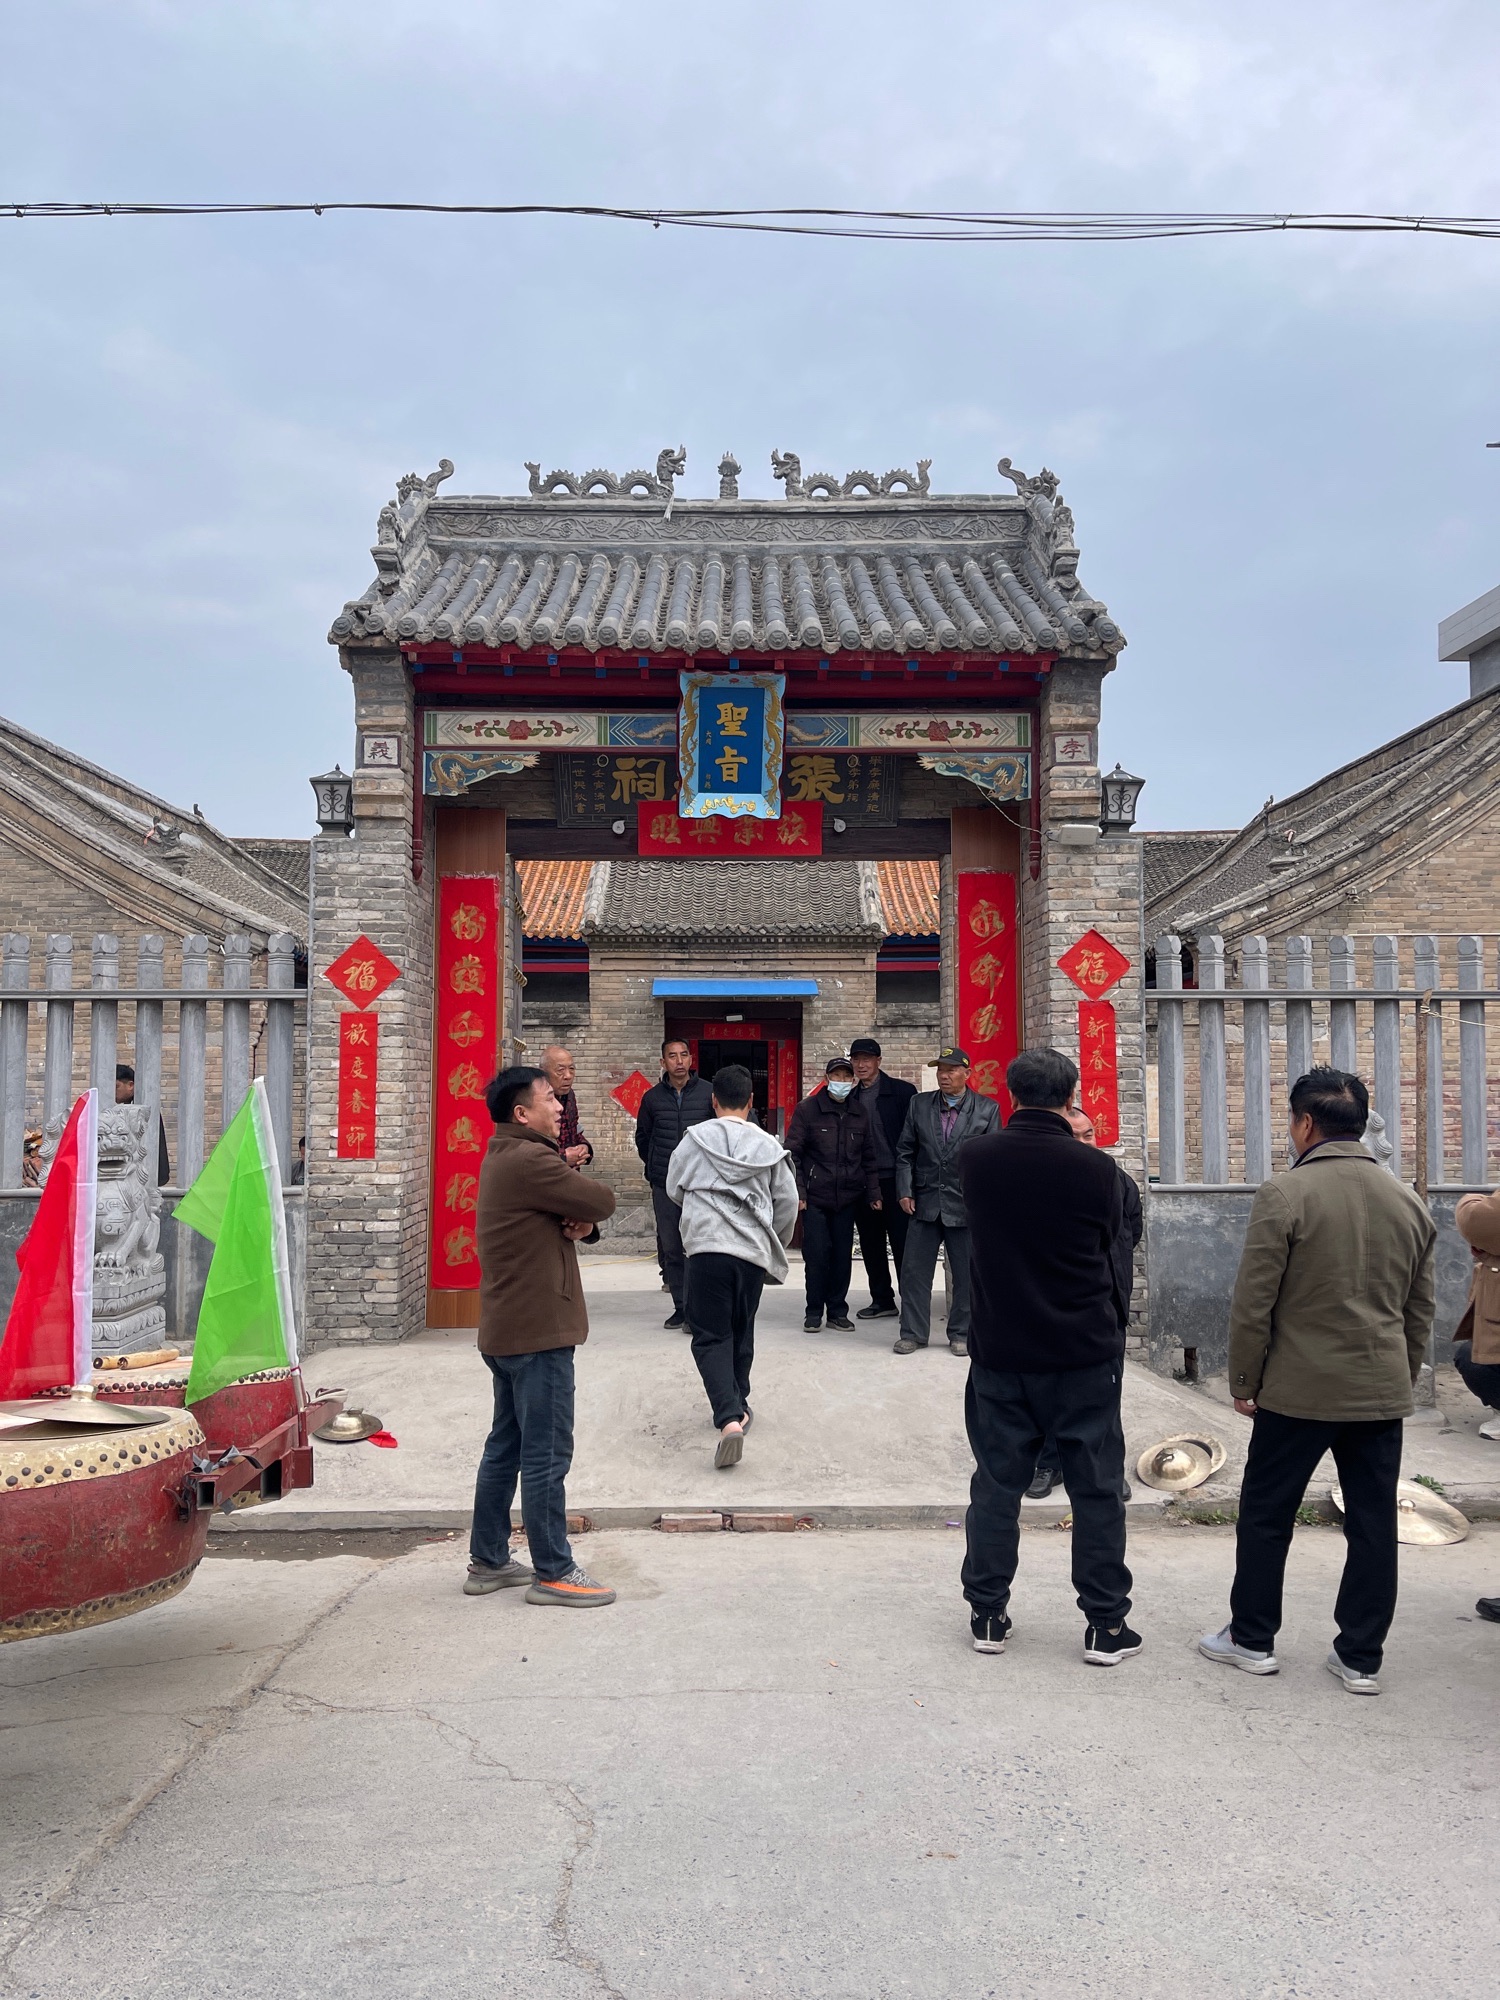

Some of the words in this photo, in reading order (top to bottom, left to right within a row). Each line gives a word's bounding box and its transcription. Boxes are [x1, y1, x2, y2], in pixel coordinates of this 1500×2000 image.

[1060, 738, 1085, 760] 孝
[342, 957, 378, 992] 福
[1074, 948, 1109, 986] 福
